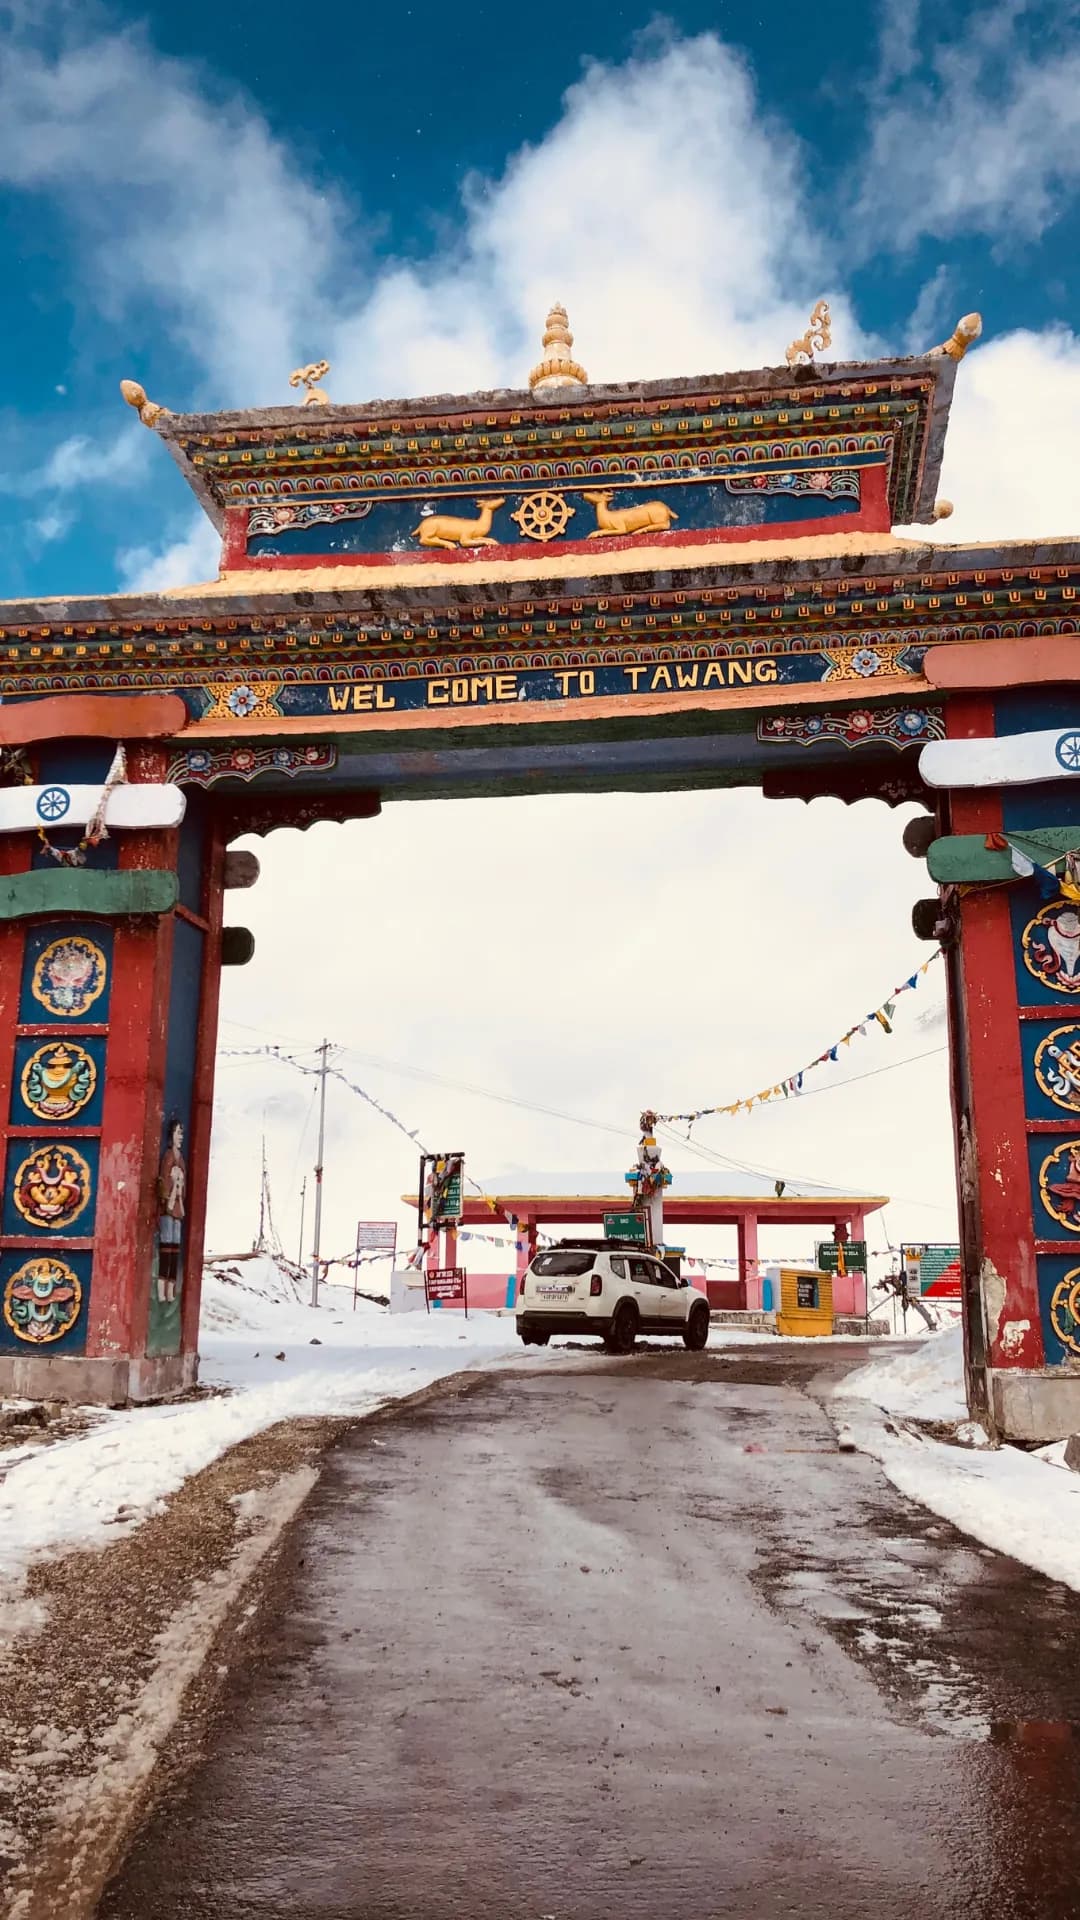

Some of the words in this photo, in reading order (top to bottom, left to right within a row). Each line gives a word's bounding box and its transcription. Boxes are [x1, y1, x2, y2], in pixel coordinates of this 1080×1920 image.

[328, 684, 396, 711] WEL
[427, 675, 519, 705] COME
[554, 670, 595, 696] TO
[623, 659, 778, 691] TAWANG
